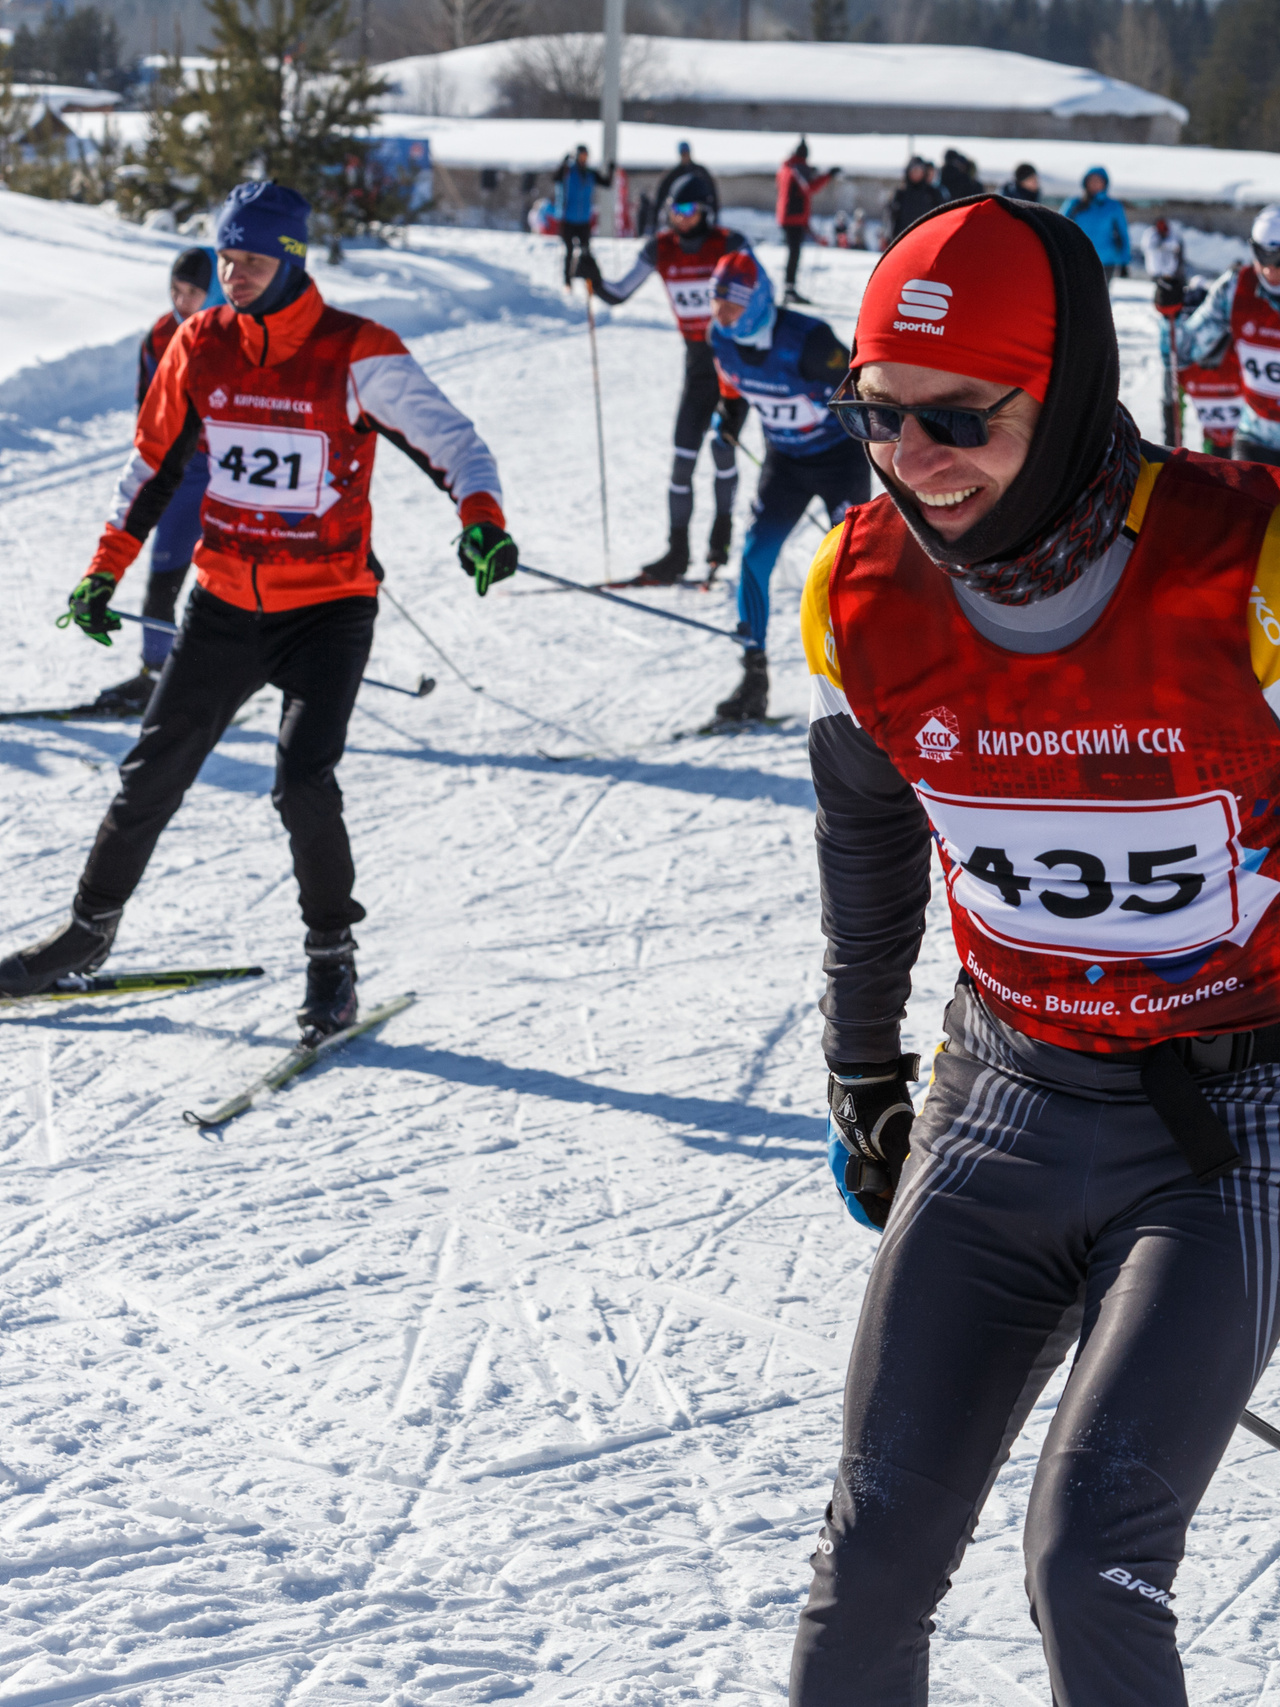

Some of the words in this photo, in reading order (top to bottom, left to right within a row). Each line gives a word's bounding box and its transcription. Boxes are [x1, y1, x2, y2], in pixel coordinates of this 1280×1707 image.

[893, 320, 945, 336] sportful
[218, 445, 302, 490] 421
[922, 731, 952, 748] КССК
[977, 724, 1129, 756] КИРОВСКИЙ
[1137, 727, 1186, 753] ССК
[960, 843, 1206, 919] 435
[966, 949, 1038, 1010] Быстрее.
[1044, 994, 1121, 1017] Выше.
[1129, 976, 1245, 1014] Сильнее.
